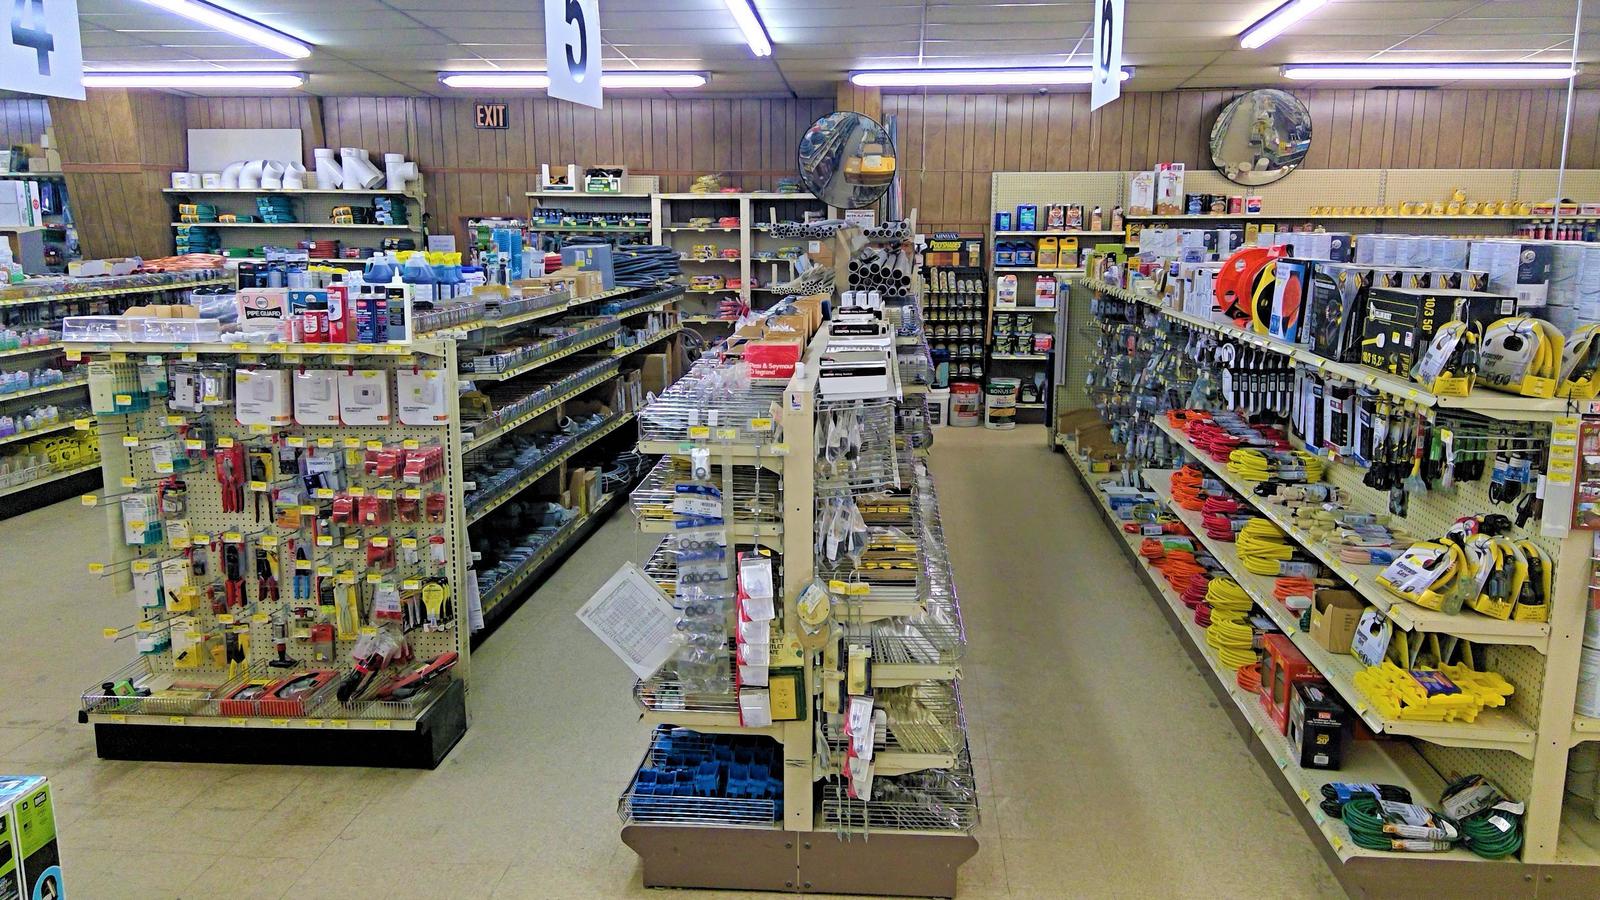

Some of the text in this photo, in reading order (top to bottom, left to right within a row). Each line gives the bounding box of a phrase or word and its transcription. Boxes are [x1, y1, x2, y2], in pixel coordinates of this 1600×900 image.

[11, 0, 54, 76] 4
[565, 0, 587, 84] 5
[1101, 0, 1113, 84] 6
[477, 105, 505, 127] EXIT
[768, 363, 794, 371] Seymour
